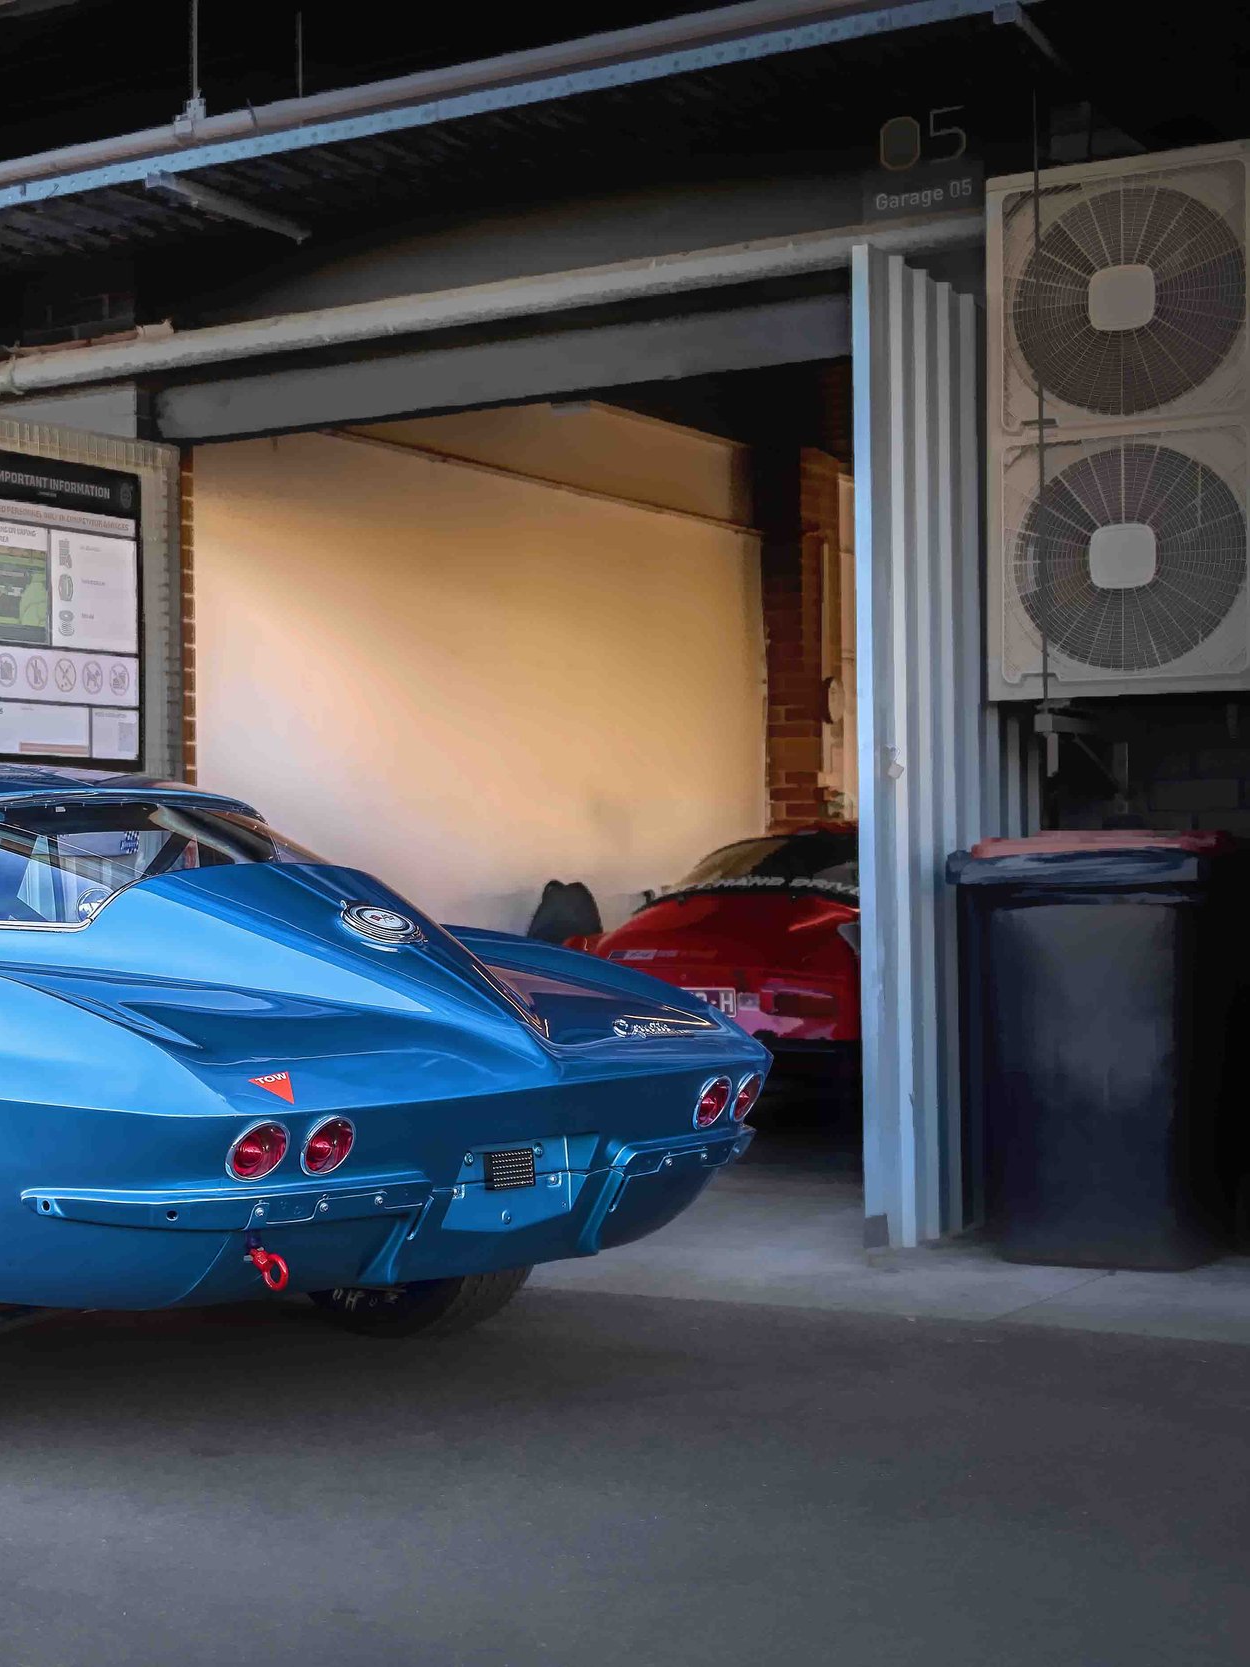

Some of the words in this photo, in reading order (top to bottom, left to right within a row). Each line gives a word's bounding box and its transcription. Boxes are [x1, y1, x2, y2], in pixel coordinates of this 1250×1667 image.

[879, 105, 967, 171] 05
[876, 187, 944, 210] Garage
[950, 179, 972, 198] 05
[50, 479, 111, 499] INFORMATION
[255, 1072, 288, 1085] TOW
